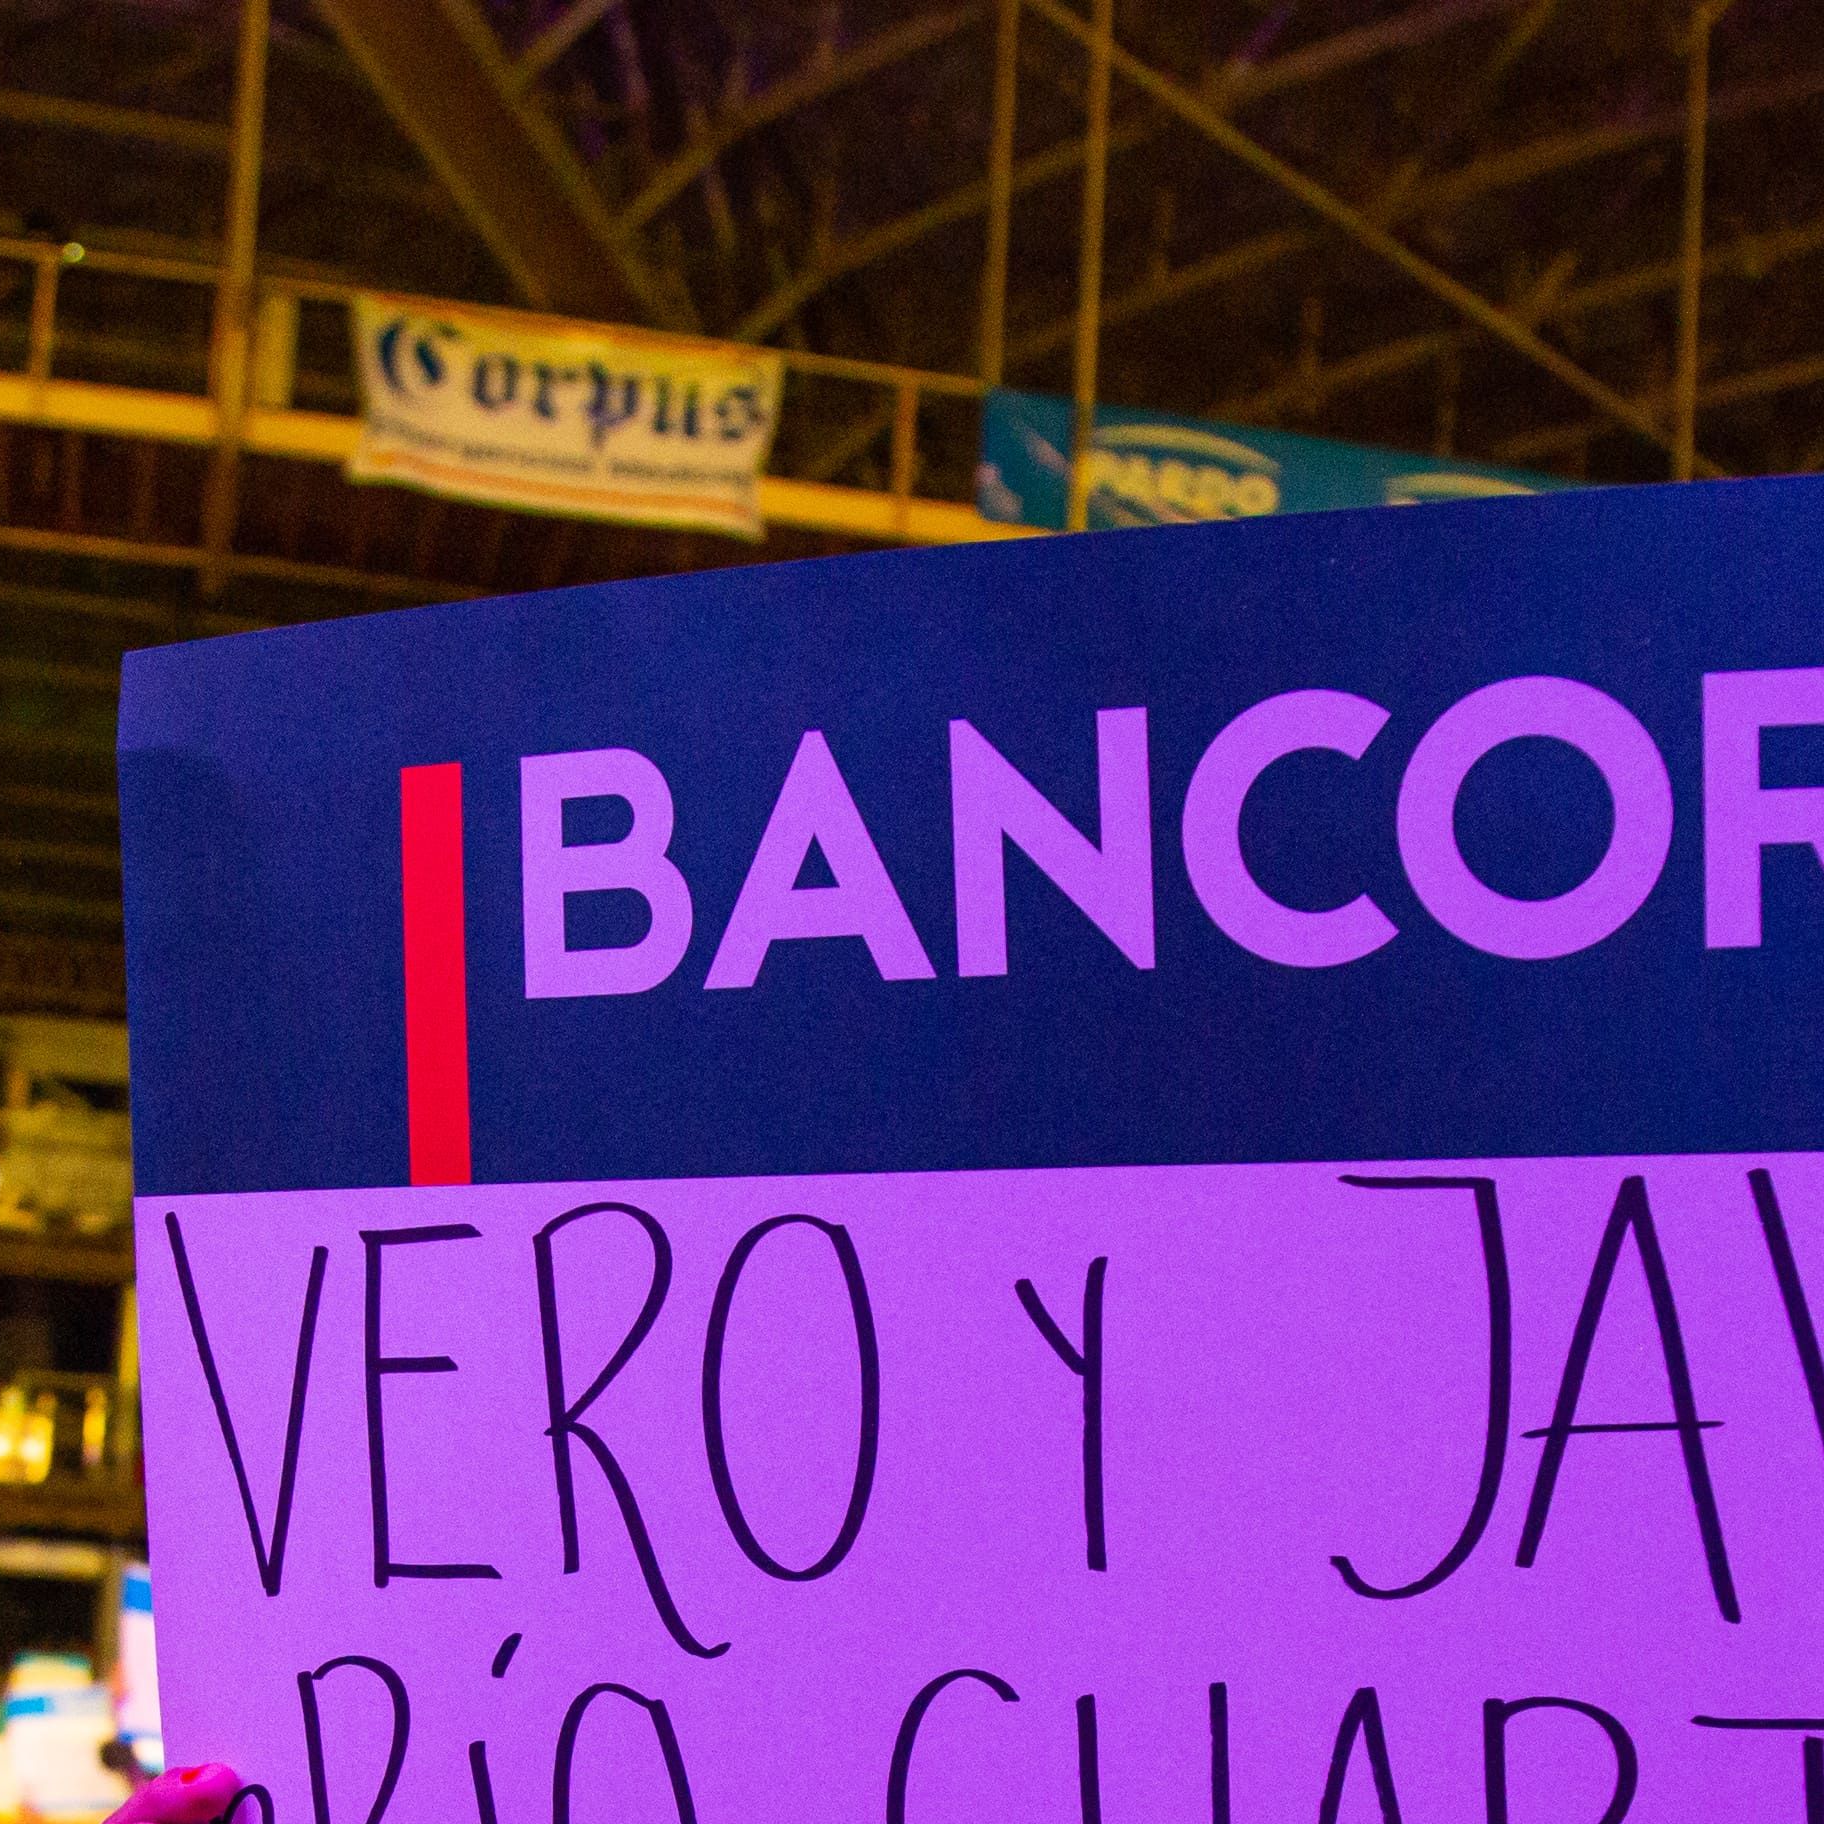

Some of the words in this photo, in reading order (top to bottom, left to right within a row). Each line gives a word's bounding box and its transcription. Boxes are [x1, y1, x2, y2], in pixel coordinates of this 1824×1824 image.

[378, 316, 763, 452] Corpus
[165, 1202, 880, 1659] VERO
[1015, 1256, 1107, 1571] Y
